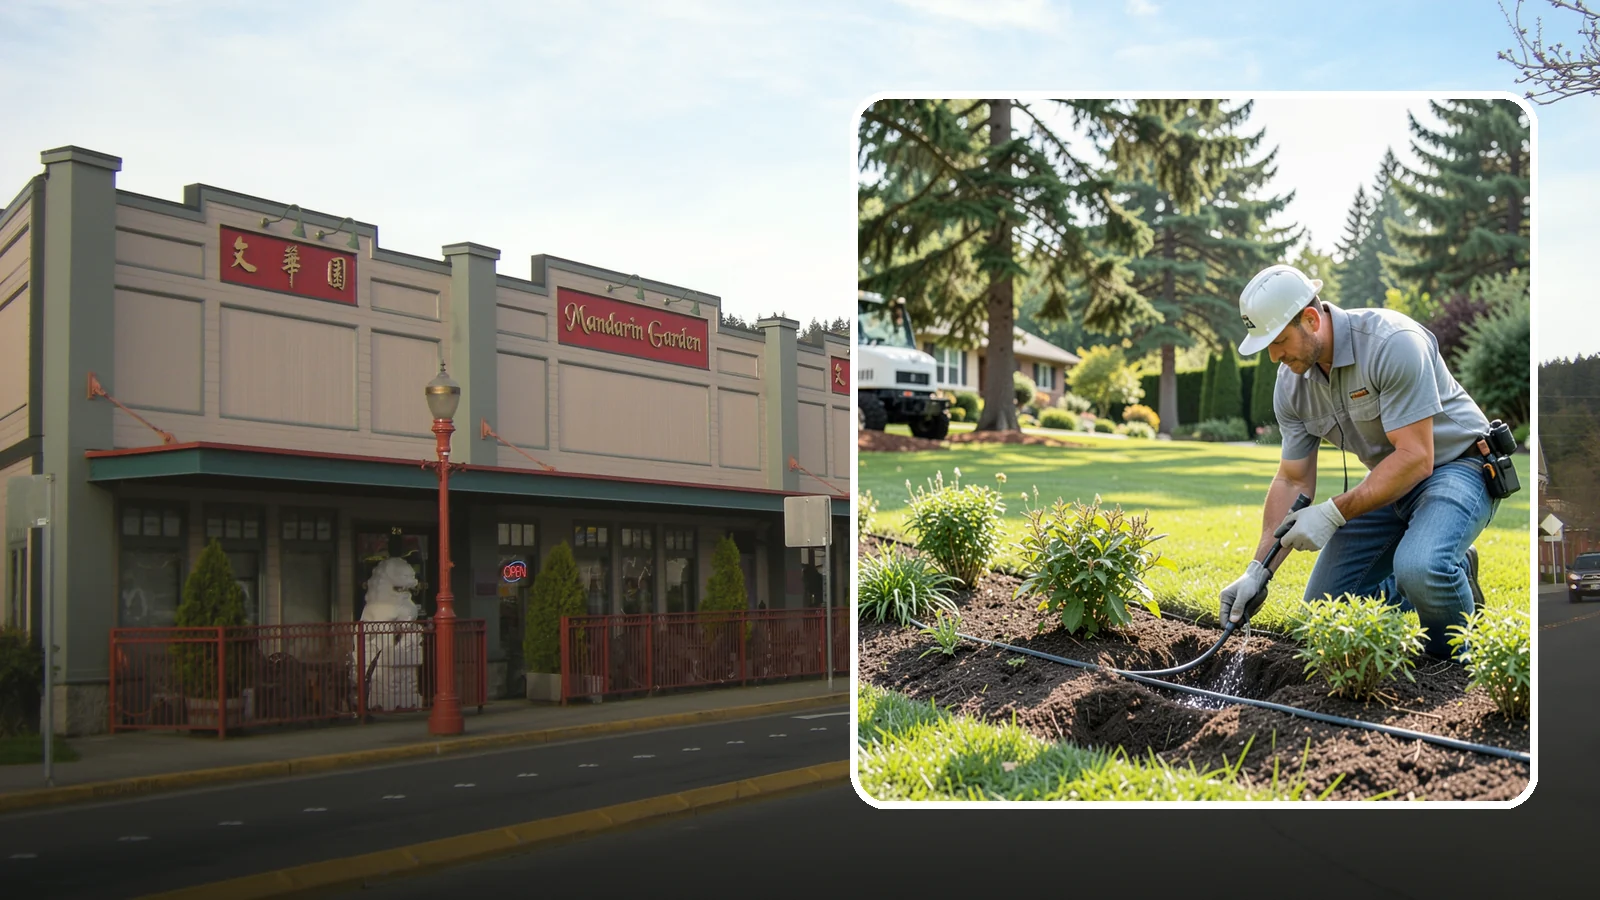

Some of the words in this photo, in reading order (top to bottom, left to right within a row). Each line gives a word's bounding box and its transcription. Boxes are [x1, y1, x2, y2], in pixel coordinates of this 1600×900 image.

[231, 236, 346, 290] 文華園
[564, 302, 644, 341] Mandarin
[647, 320, 702, 352] Garden
[503, 565, 527, 578] OPEN
